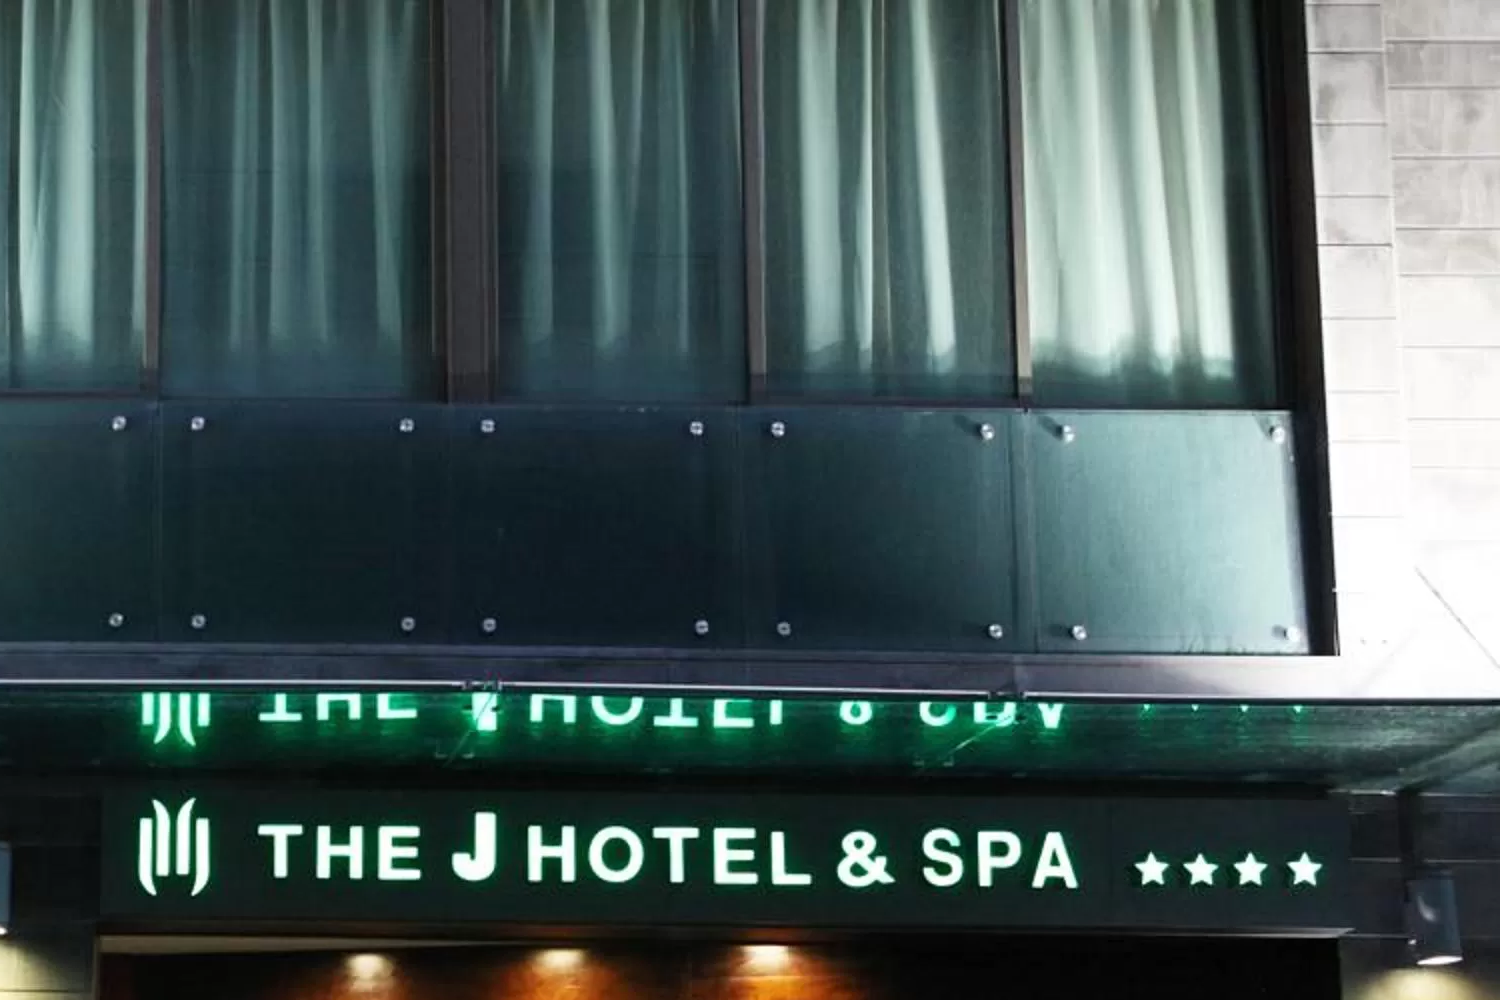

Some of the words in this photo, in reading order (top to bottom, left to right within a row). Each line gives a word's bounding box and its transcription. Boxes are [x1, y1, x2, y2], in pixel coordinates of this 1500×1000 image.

[257, 823, 422, 881] THE
[451, 811, 498, 882] J
[526, 824, 813, 886] HOTEL
[836, 829, 896, 888] &
[921, 827, 1079, 890] SPA
